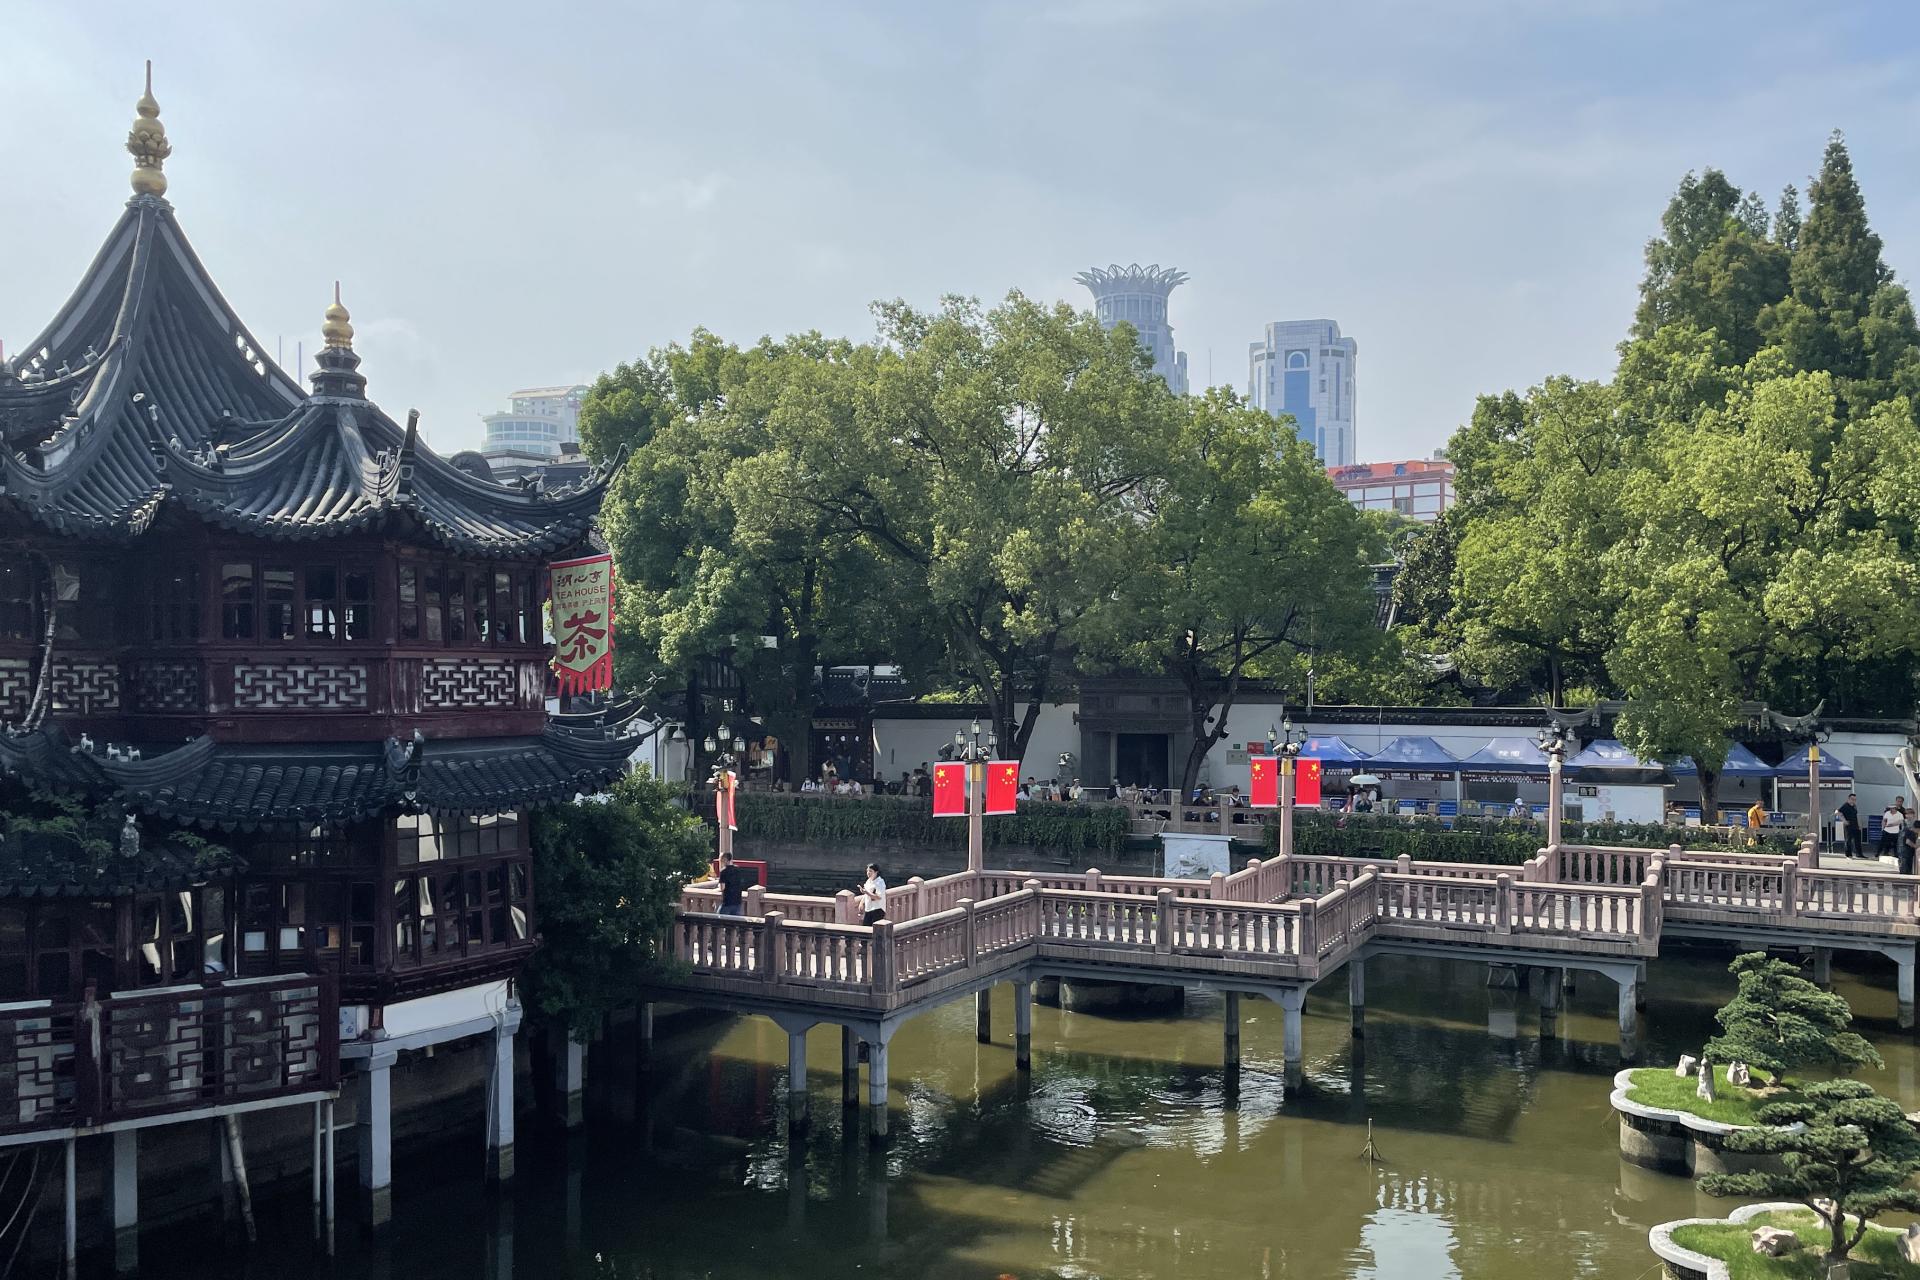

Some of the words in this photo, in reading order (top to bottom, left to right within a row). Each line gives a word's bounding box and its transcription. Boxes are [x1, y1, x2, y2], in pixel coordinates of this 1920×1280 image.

[556, 590, 573, 600] TEA
[575, 585, 606, 597] HOUSE
[561, 610, 606, 663] 茶
